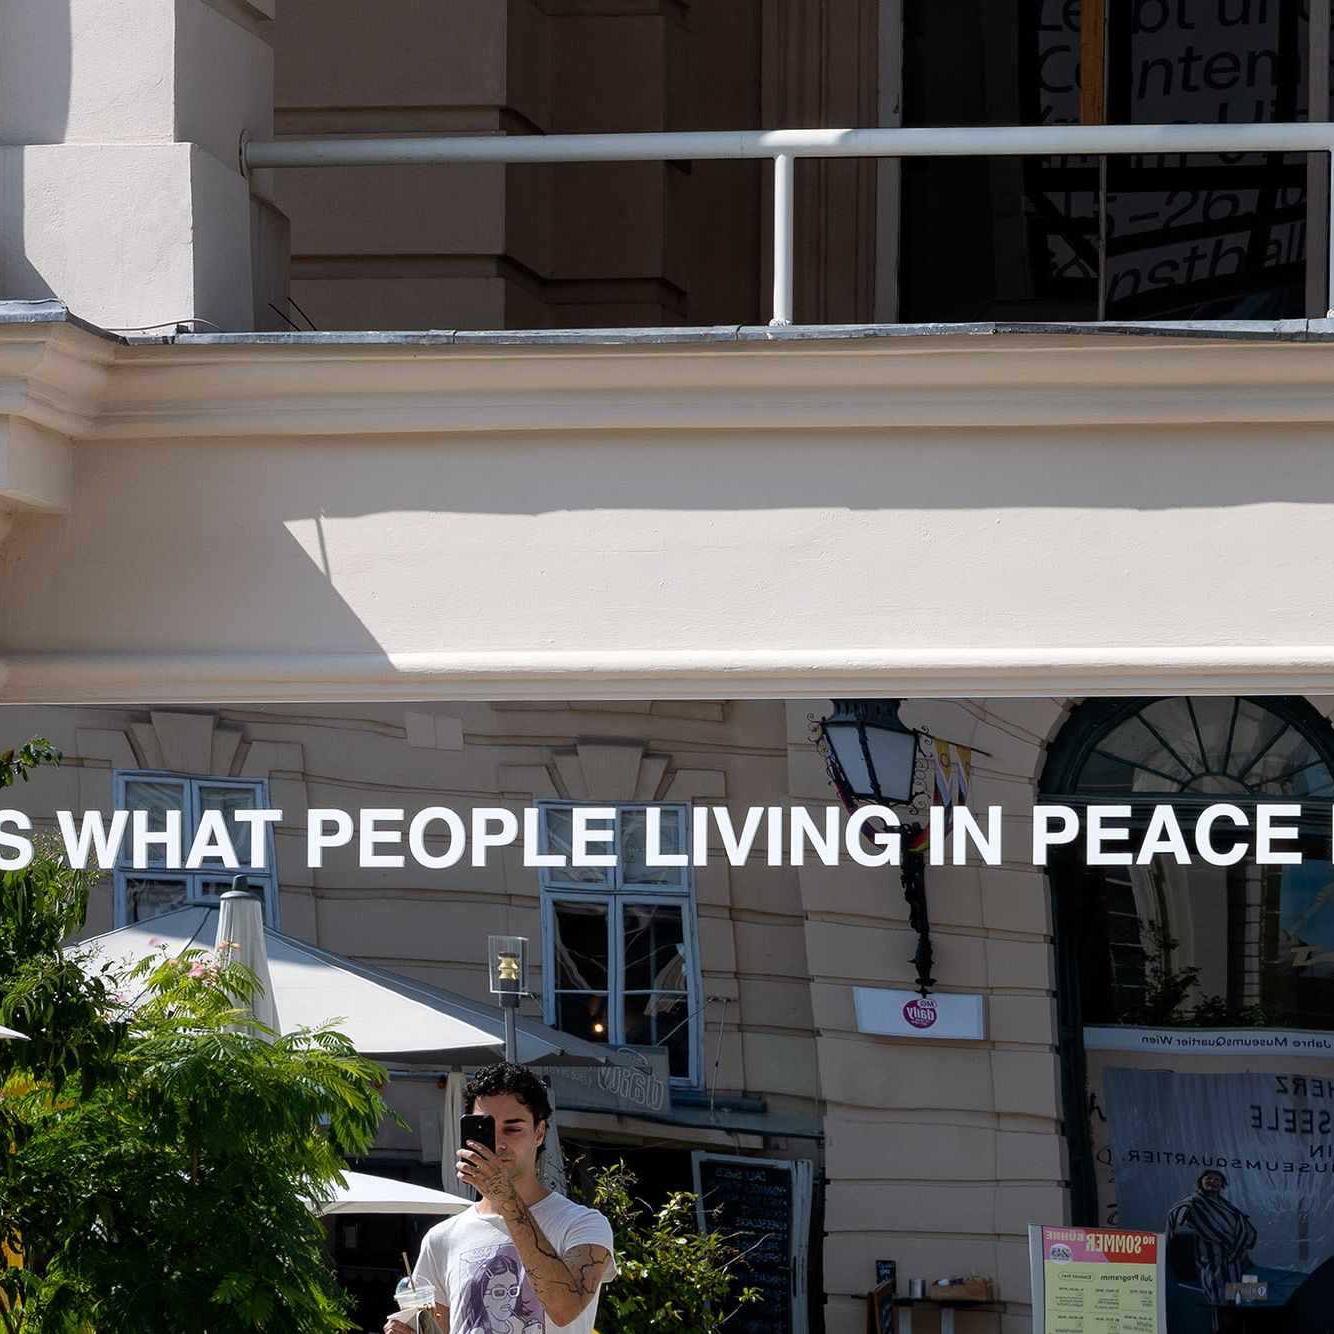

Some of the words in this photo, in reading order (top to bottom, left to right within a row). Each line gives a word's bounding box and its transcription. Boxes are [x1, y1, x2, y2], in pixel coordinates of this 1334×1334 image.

[57, 808, 282, 868] WHAT
[308, 806, 617, 867] PEOPLE
[647, 806, 900, 866] LIVING
[931, 806, 1001, 865] IN
[1033, 804, 1301, 865] PEACE
